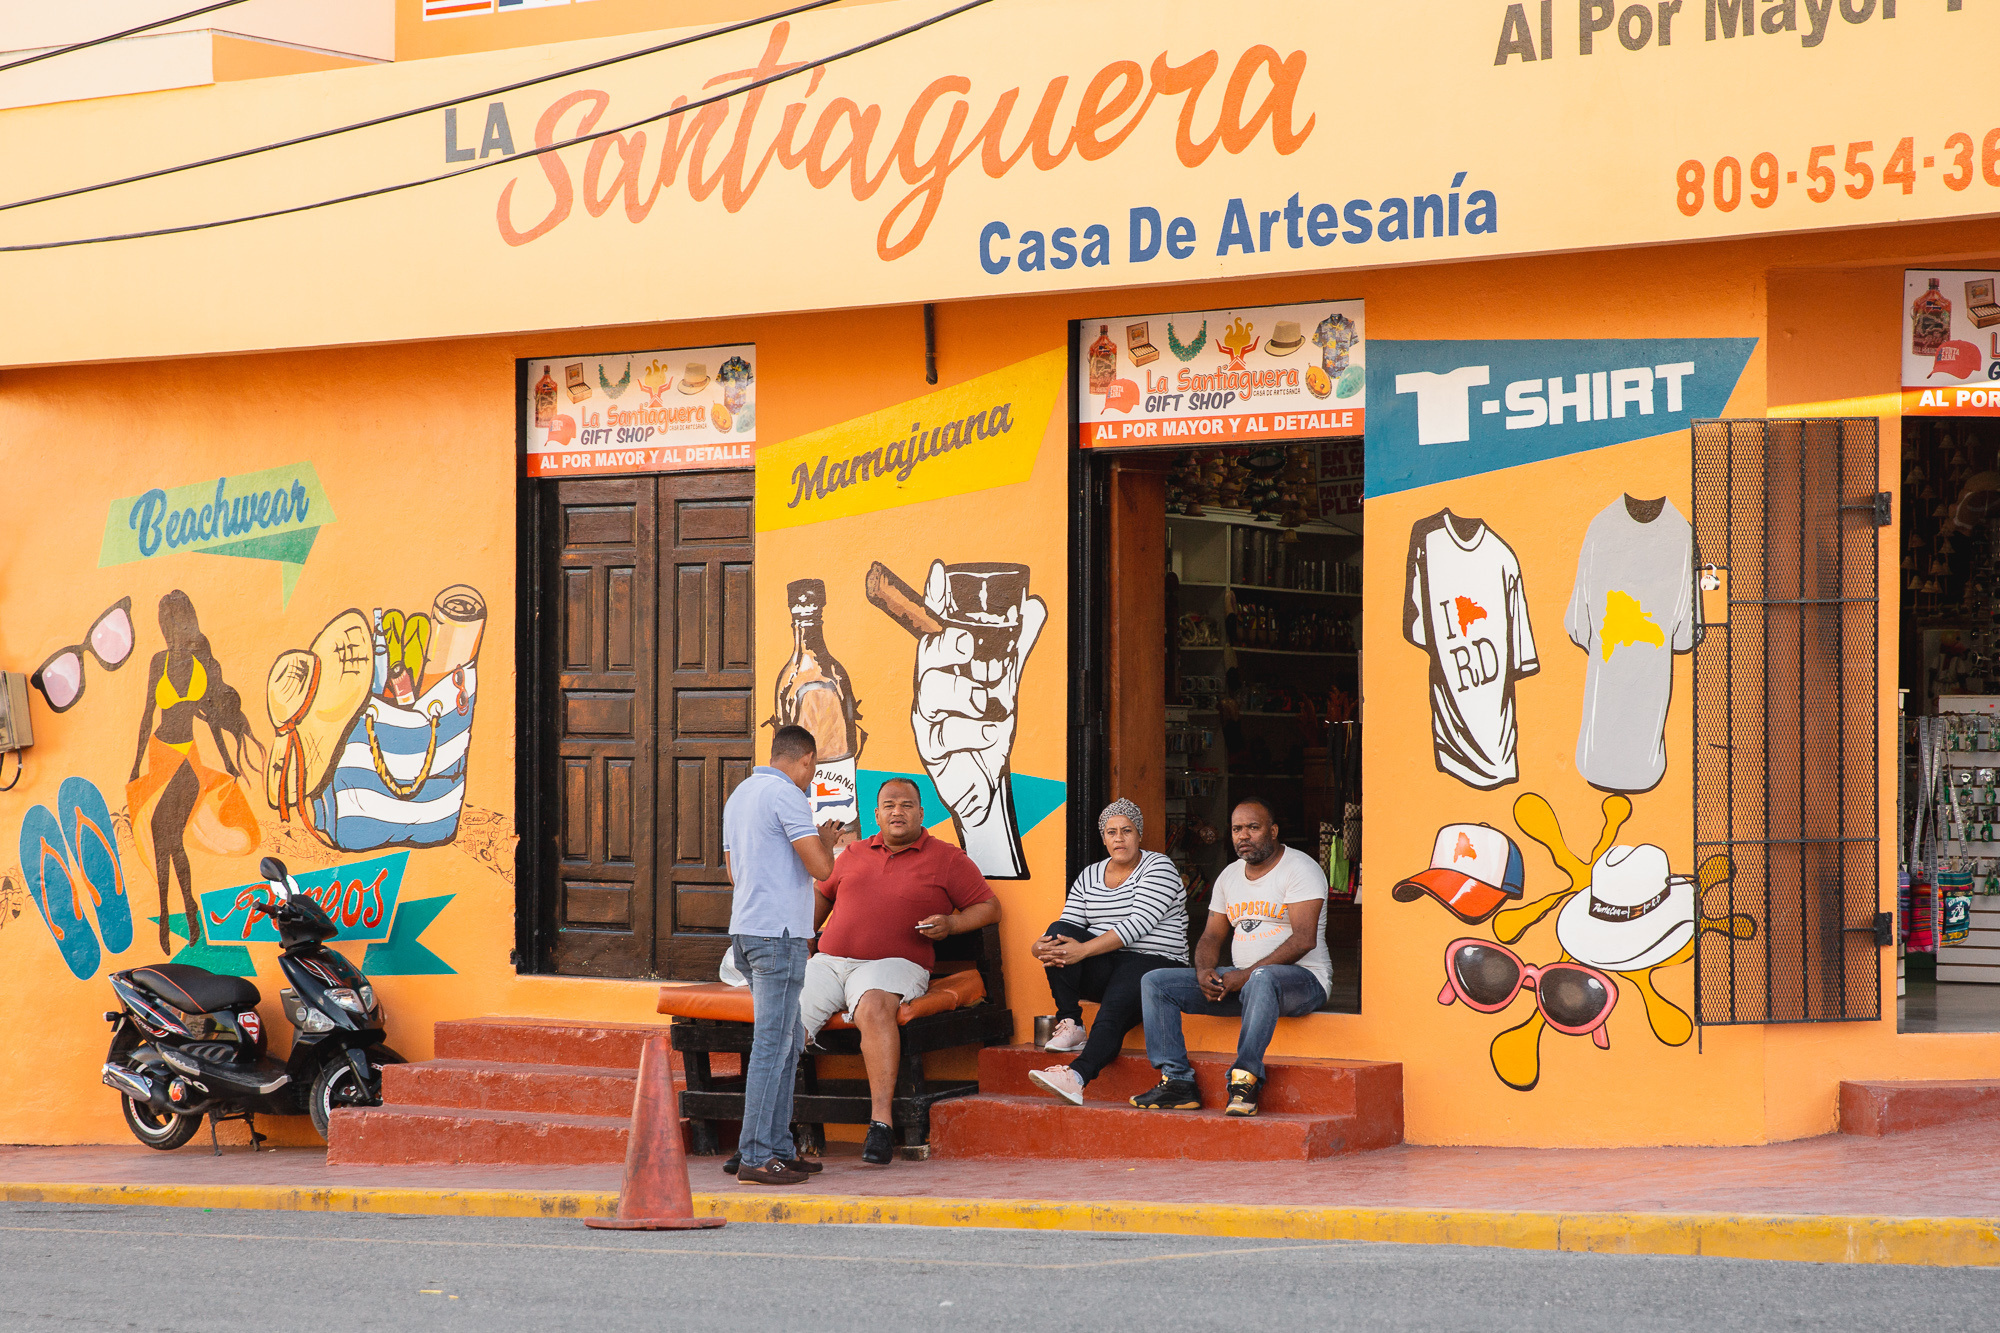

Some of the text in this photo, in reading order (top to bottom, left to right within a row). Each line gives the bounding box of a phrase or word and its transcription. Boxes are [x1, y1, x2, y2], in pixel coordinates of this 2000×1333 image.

[1494, 0, 1553, 66] Al
[1579, 0, 1683, 55] Por
[446, 21, 1316, 262] LA Santiaguera
[980, 171, 1498, 275] Casa De Artesanía
[1145, 364, 1300, 401] La Santiaguera
[1145, 391, 1236, 413] GIFT SHOP
[1919, 390, 2000, 408] AL POR
[581, 405, 601, 428] La
[607, 402, 706, 435] Santiaguera
[1395, 361, 1696, 446] T-SHIRT
[580, 426, 655, 446] GIFT SHOP
[1096, 412, 1354, 440] AL POR MAYOR Y AL DETALLE
[540, 444, 751, 470] AL POR MAYOR Y AL DETALLE
[787, 402, 1015, 509] Mamajuana
[129, 477, 310, 558] Beachwear
[1439, 600, 1457, 640] I
[1449, 637, 1499, 693] RD
